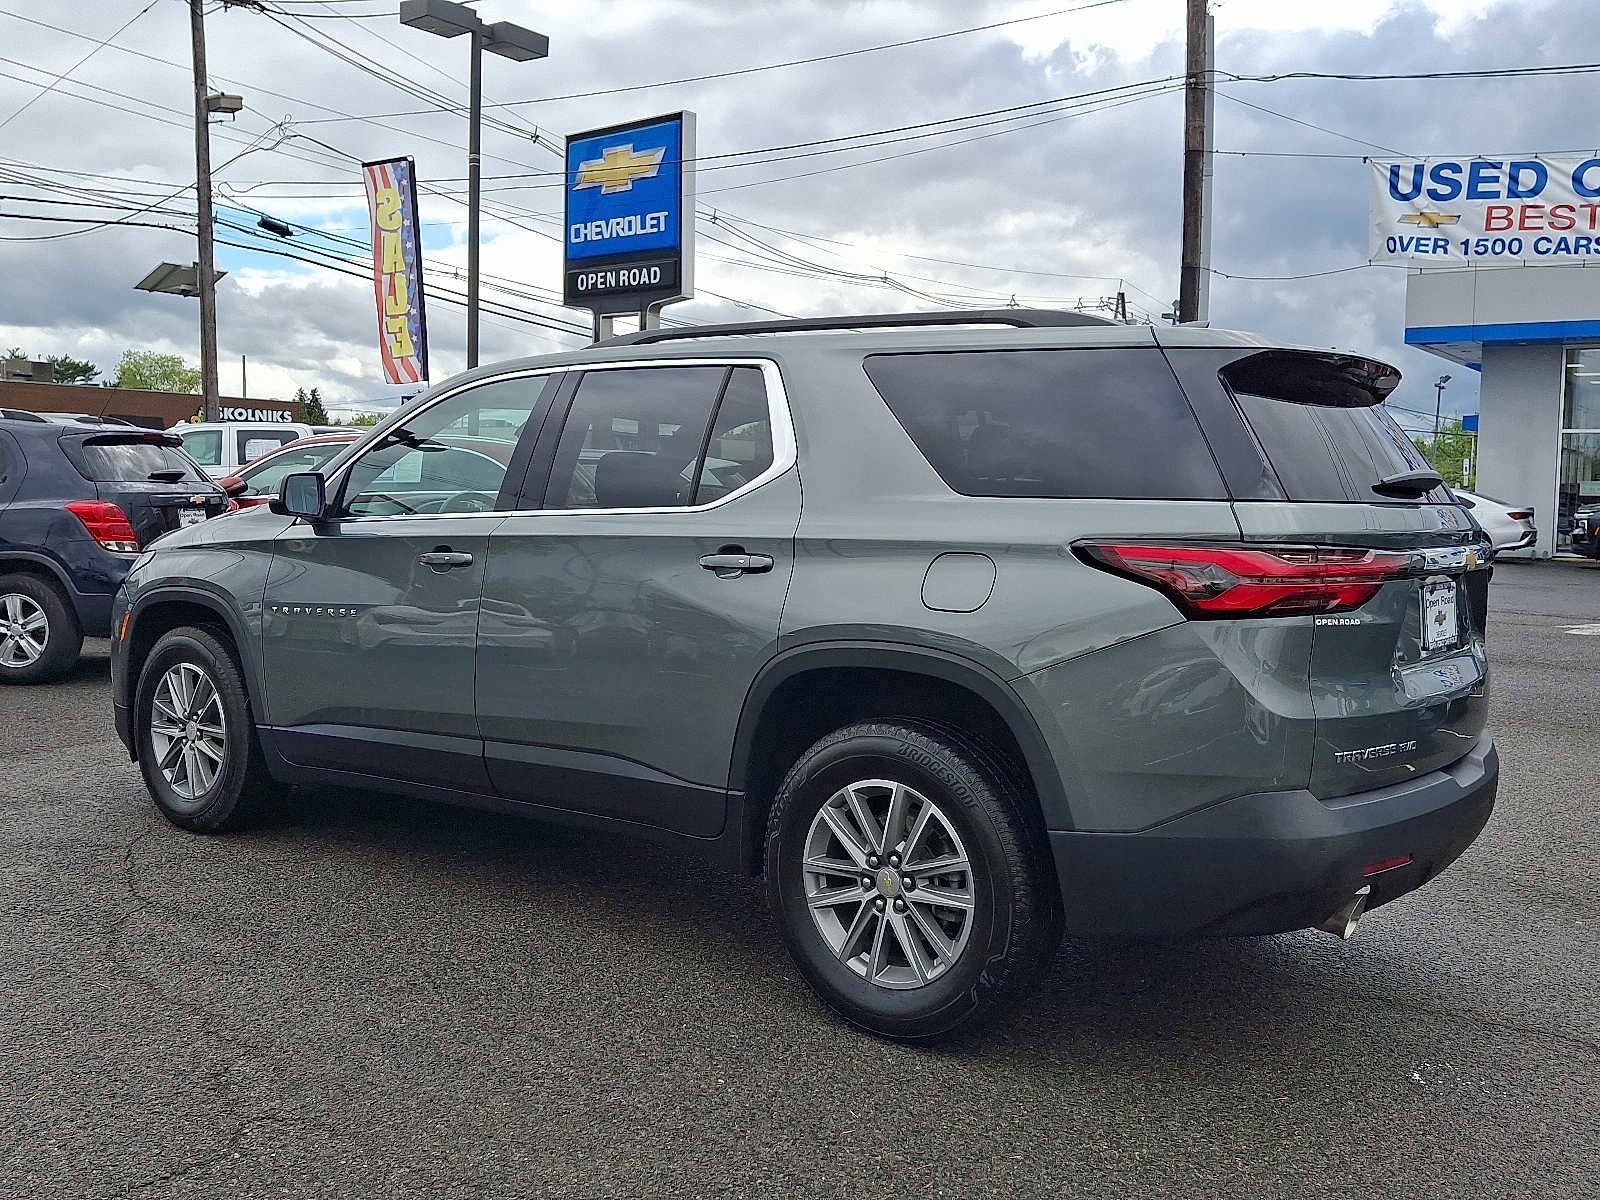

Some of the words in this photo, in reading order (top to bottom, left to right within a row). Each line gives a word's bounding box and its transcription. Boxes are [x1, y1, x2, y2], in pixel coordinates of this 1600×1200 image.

[1389, 161, 1549, 201] USED
[570, 211, 668, 243] CHEVROLET
[1484, 204, 1600, 232] BEST
[1386, 236, 1450, 255] OVER
[1460, 237, 1523, 255] 1500
[577, 271, 616, 291] OPEN
[619, 266, 661, 286] ROAD
[219, 407, 292, 423] SKOLNIKS
[272, 606, 357, 617] TRAVERSE
[1334, 743, 1398, 763] TRAVERSE
